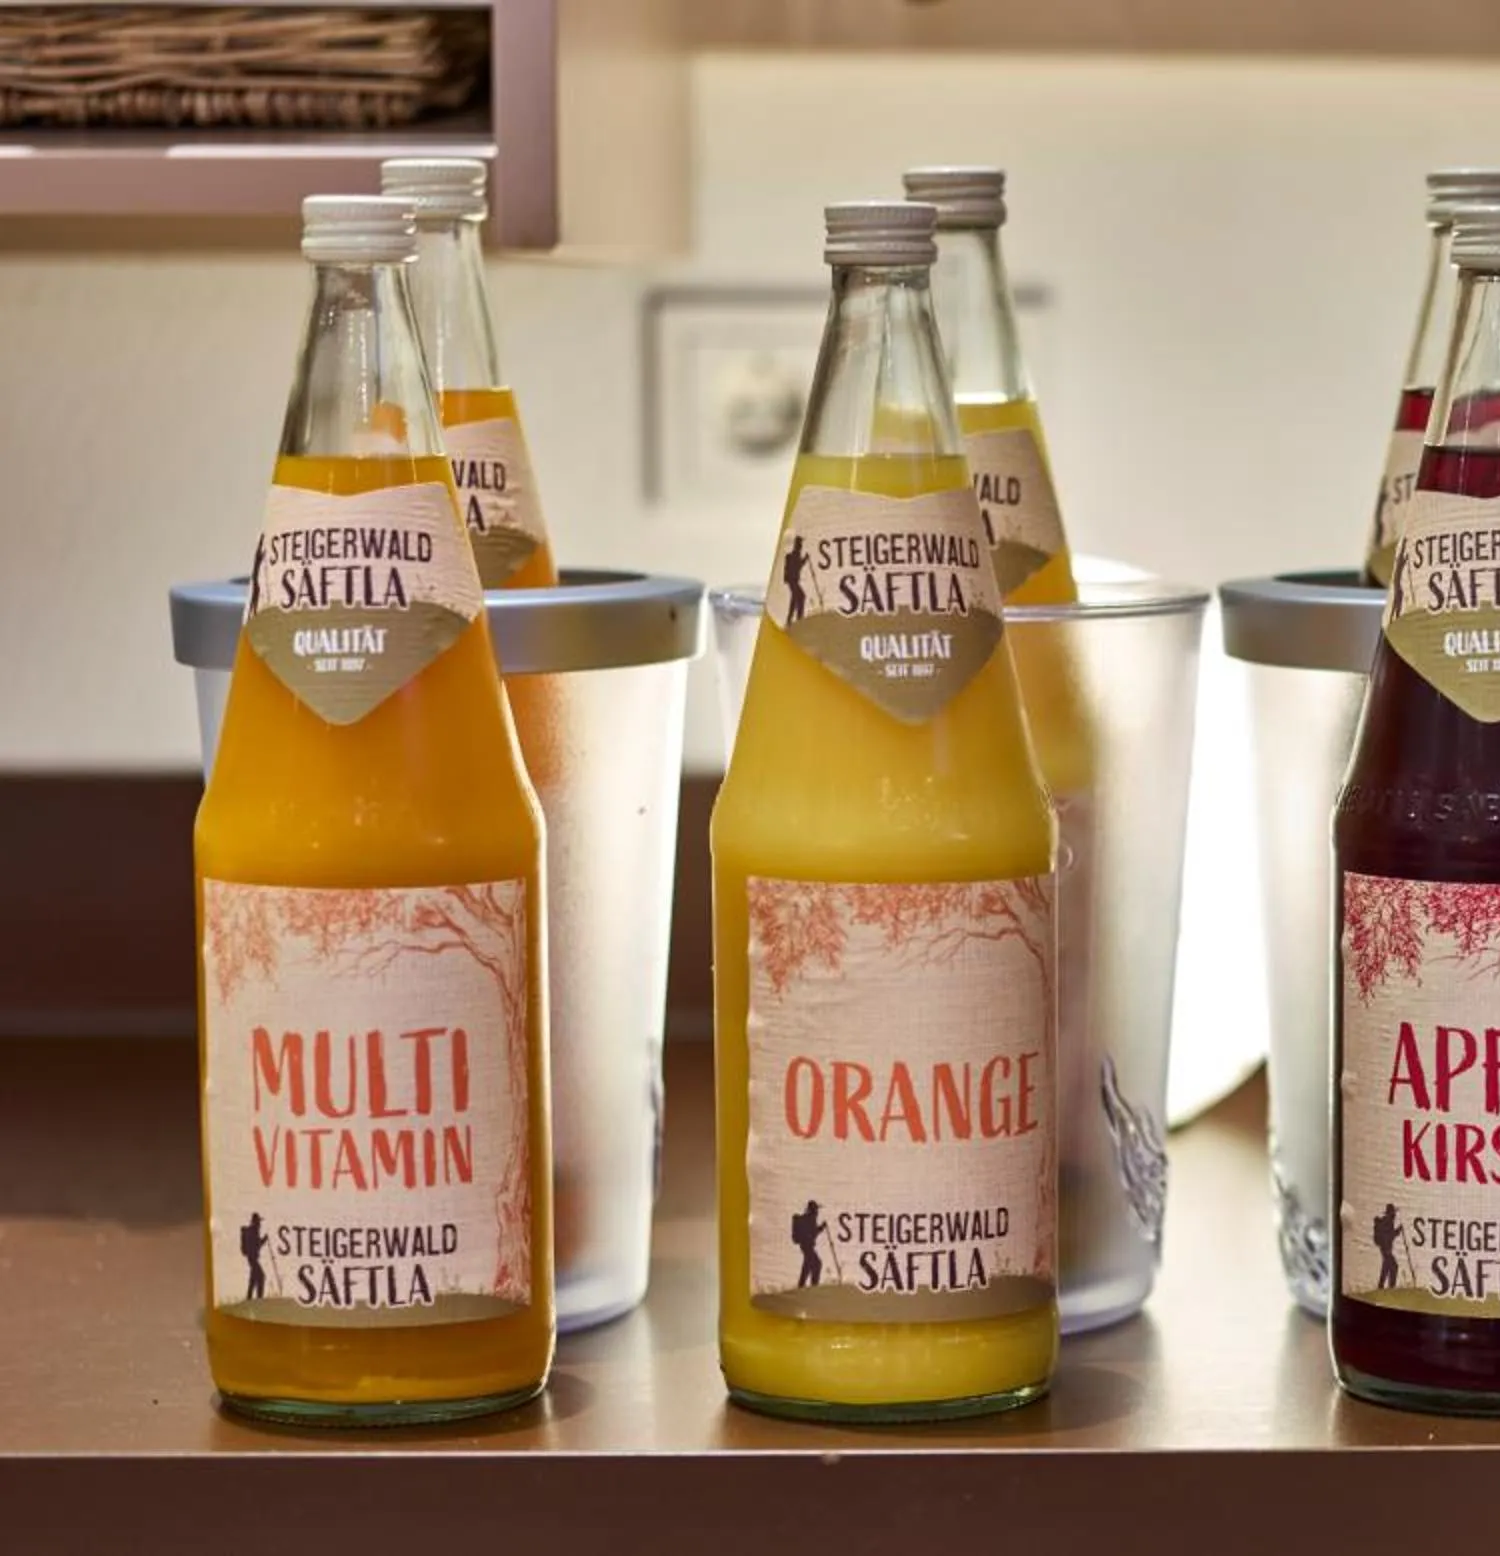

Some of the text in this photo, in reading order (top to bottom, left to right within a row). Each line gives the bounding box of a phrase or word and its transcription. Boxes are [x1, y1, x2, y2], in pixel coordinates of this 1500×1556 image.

[270, 527, 433, 565] STEIGERWALD
[818, 532, 980, 570] STEIGERWALD
[281, 557, 410, 609] SÄFTLA
[838, 564, 968, 615] SÄFTLA
[252, 1024, 471, 1119] MULTI
[784, 1052, 1040, 1144] ORANGE
[252, 1124, 474, 1191] VITAMIN
[277, 1222, 458, 1259] STEIGERWALD
[837, 1206, 1010, 1245] STEIGERWALD
[297, 1258, 433, 1306] SÄFTLA
[858, 1244, 988, 1292] SÄFTLA
